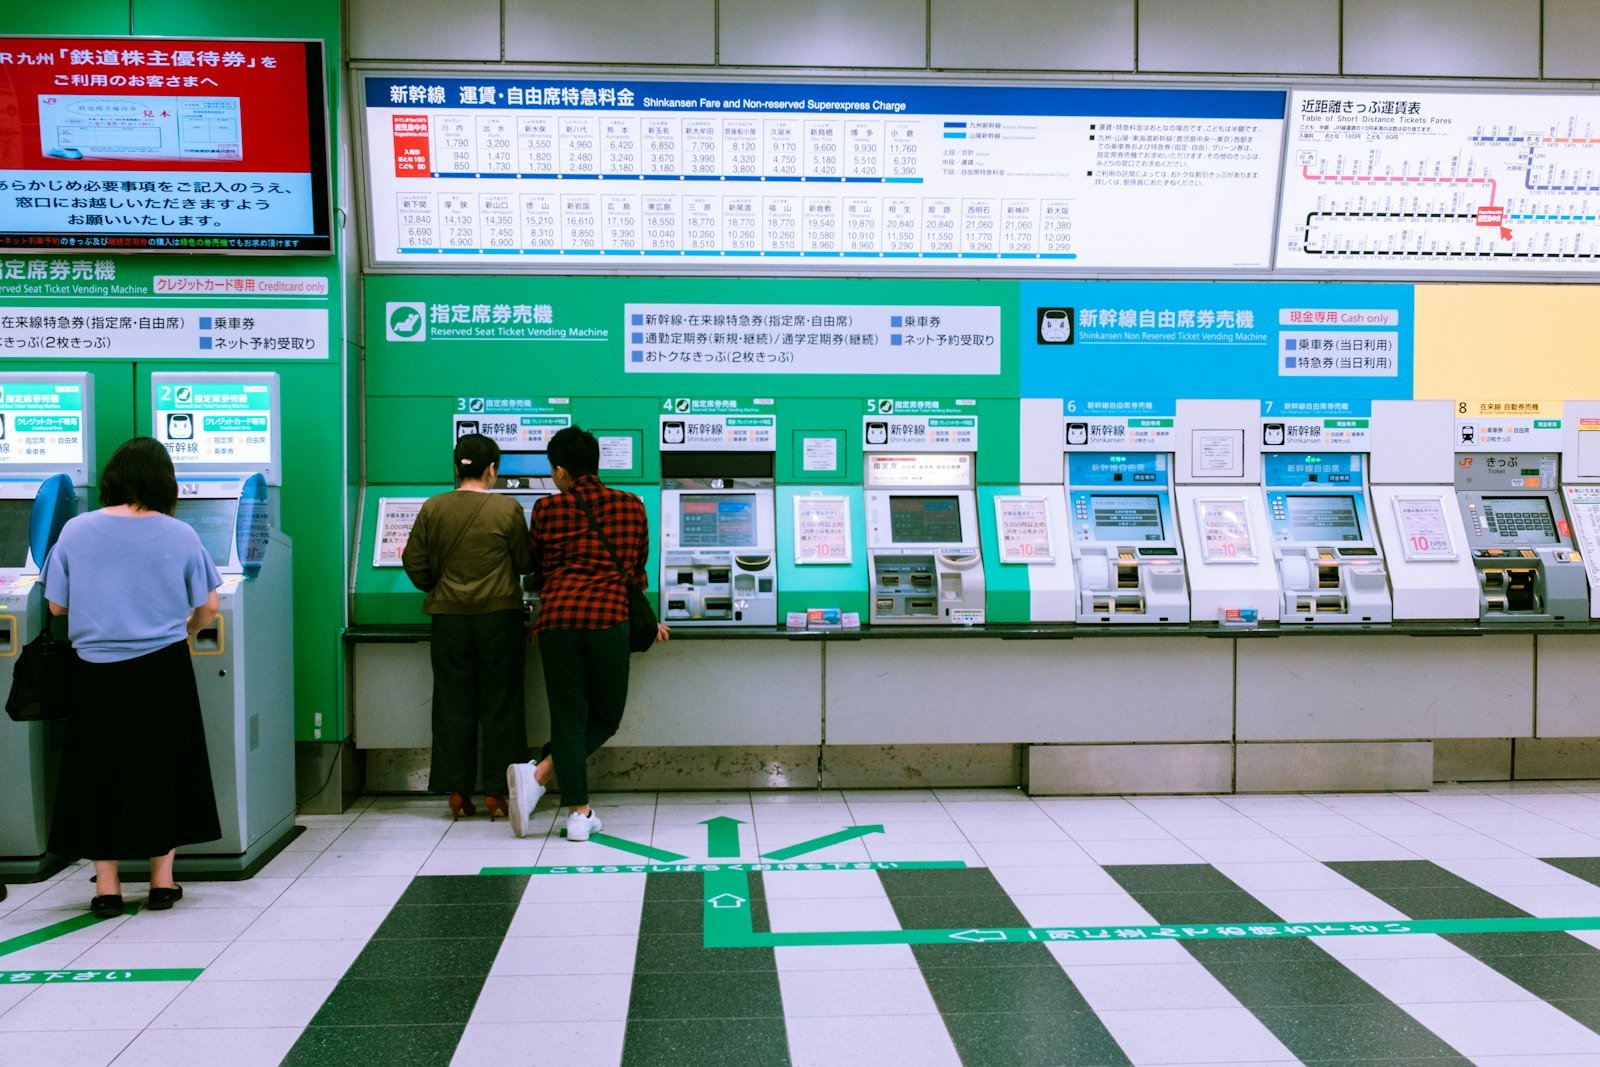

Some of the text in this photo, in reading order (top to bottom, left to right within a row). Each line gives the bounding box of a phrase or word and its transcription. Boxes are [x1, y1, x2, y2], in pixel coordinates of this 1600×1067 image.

[53, 74, 218, 88] ご利用のお客さまへ
[390, 85, 635, 107] 新幹線 運賃・自由席特急料金
[643, 97, 906, 113] Shinkansen Fare and Non-reserved Superexpress Charge
[1301, 99, 1421, 115] 近距離きっぷ運賃表
[1337, 115, 1358, 123] Short
[1362, 116, 1395, 124] Distance
[446, 139, 468, 149] 1,790
[487, 139, 510, 150] 3,200
[528, 140, 551, 150] 3,550
[569, 141, 592, 150] 4,960
[610, 141, 633, 151] 6,420
[651, 141, 674, 151] 6,850
[692, 142, 715, 152] 7,790
[733, 143, 755, 151] 8,120
[773, 143, 796, 152] 9,170
[854, 144, 876, 153] 9,930
[891, 145, 917, 154] 11,760
[15, 197, 271, 211] 窓口にお越しいただきますよう
[67, 213, 223, 227] お願いいたします。
[404, 215, 1071, 231] 12,840 14,130 14,350 15,210 16,610 17,150 18,550 18,770 18,770 18,770 19,540 19,870 20,840 20,840 21,060 21,060 21,380
[0, 259, 116, 281] 定席券売機
[23, 284, 42, 294] Seat
[45, 284, 70, 294] Ticket
[72, 284, 109, 295] Vending
[111, 284, 148, 295] Machine
[157, 278, 325, 294] クレジットカード専用 Creditcard only
[429, 303, 554, 325] 指定席券売機
[1079, 308, 1255, 330] 新幹線自由席券売機
[1290, 311, 1388, 326] 現金専用 Cash only
[214, 317, 256, 330] 乗車券
[904, 314, 941, 329] 乗車券
[431, 326, 609, 340] Reserved Seat Ticket Vending Machine
[904, 332, 996, 347] ネット予約受取り
[1079, 330, 1268, 345] Shinkansen Non Reserved Ticket Vending Machine
[0, 335, 316, 350] きっぷ(2枚きっぷ) ネット予約受取り
[1298, 337, 1393, 352] 乗車券(当日利用)
[645, 349, 795, 365] おトクなきっぷ(2枚きっぷ)
[1298, 355, 1393, 371] 特急券(当日利用)
[160, 386, 172, 401] 2
[194, 394, 248, 404] 指定席券売機
[457, 398, 532, 411] 3 指定席券売機
[663, 398, 737, 411] 4 指定席券売機
[867, 399, 940, 412] 5 指定席券売機
[1067, 400, 1077, 413] 6
[1087, 401, 1153, 410] 新幹線自由席券売機
[1264, 401, 1273, 413] 7
[1284, 402, 1349, 411] 新幹線自由席券売機
[1458, 402, 1539, 414] 8 在来線 自動券売機
[481, 423, 518, 435] 新幹線
[687, 423, 723, 435] 新幹線
[890, 424, 926, 436] 新幹線
[1090, 425, 1125, 437] 新幹線
[1287, 425, 1321, 437] 新幹線
[57, 437, 78, 445] 自由席
[246, 437, 266, 445] 自由席
[687, 435, 723, 443] Shinkansen
[1458, 457, 1473, 466] JR
[1486, 457, 1518, 468] きっぷ
[816, 544, 829, 556] 10
[1019, 544, 1034, 556] 10
[1222, 544, 1236, 556] 10
[1410, 536, 1429, 551] 10
[550, 862, 900, 873] こちらでしばらくお待ち下さい
[0, 971, 132, 982] ち下さい
